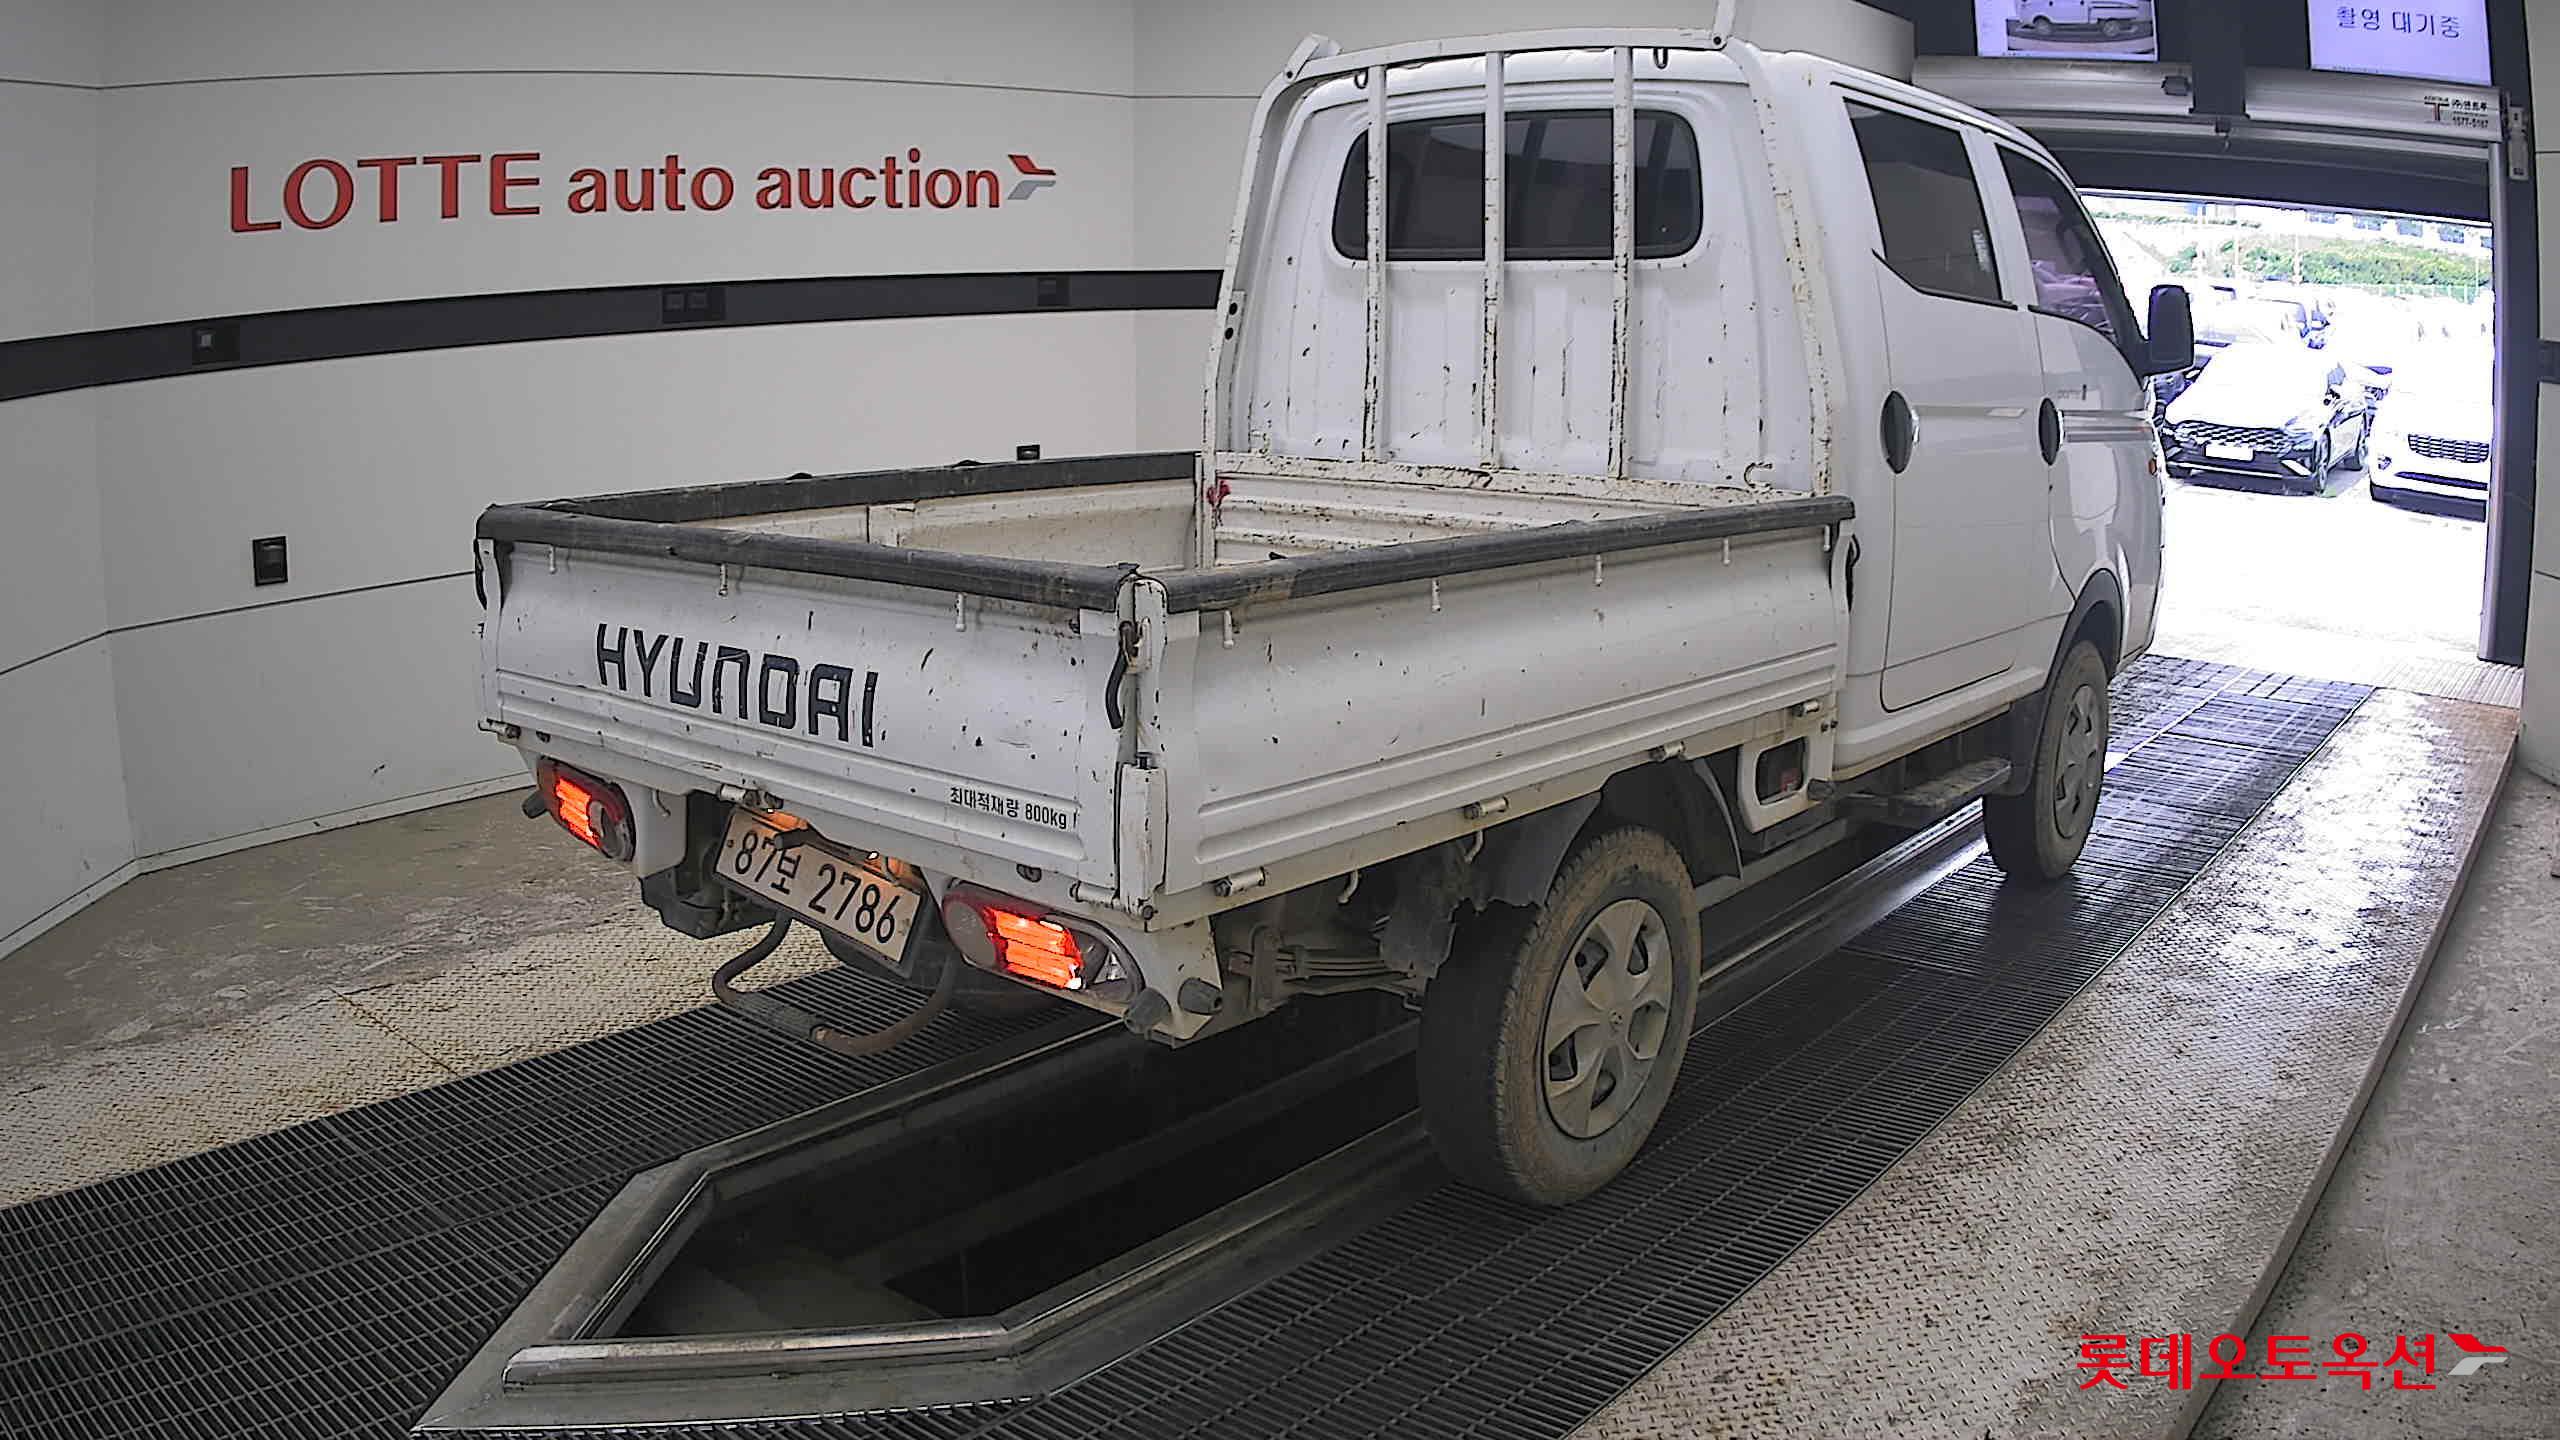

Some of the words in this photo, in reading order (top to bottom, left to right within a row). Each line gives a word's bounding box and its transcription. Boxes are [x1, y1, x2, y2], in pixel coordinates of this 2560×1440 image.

[2337, 6, 2380, 31] 촬영
[2392, 12, 2460, 39] 대기중
[231, 152, 540, 233] LOTTE
[567, 155, 734, 214] auto
[755, 148, 1000, 209] auction
[596, 623, 879, 748] HYUNDAI
[950, 787, 1019, 818] 최대적재량
[1025, 803, 1067, 830] 800kg
[735, 830, 801, 895] 87보
[808, 863, 900, 944] 2786
